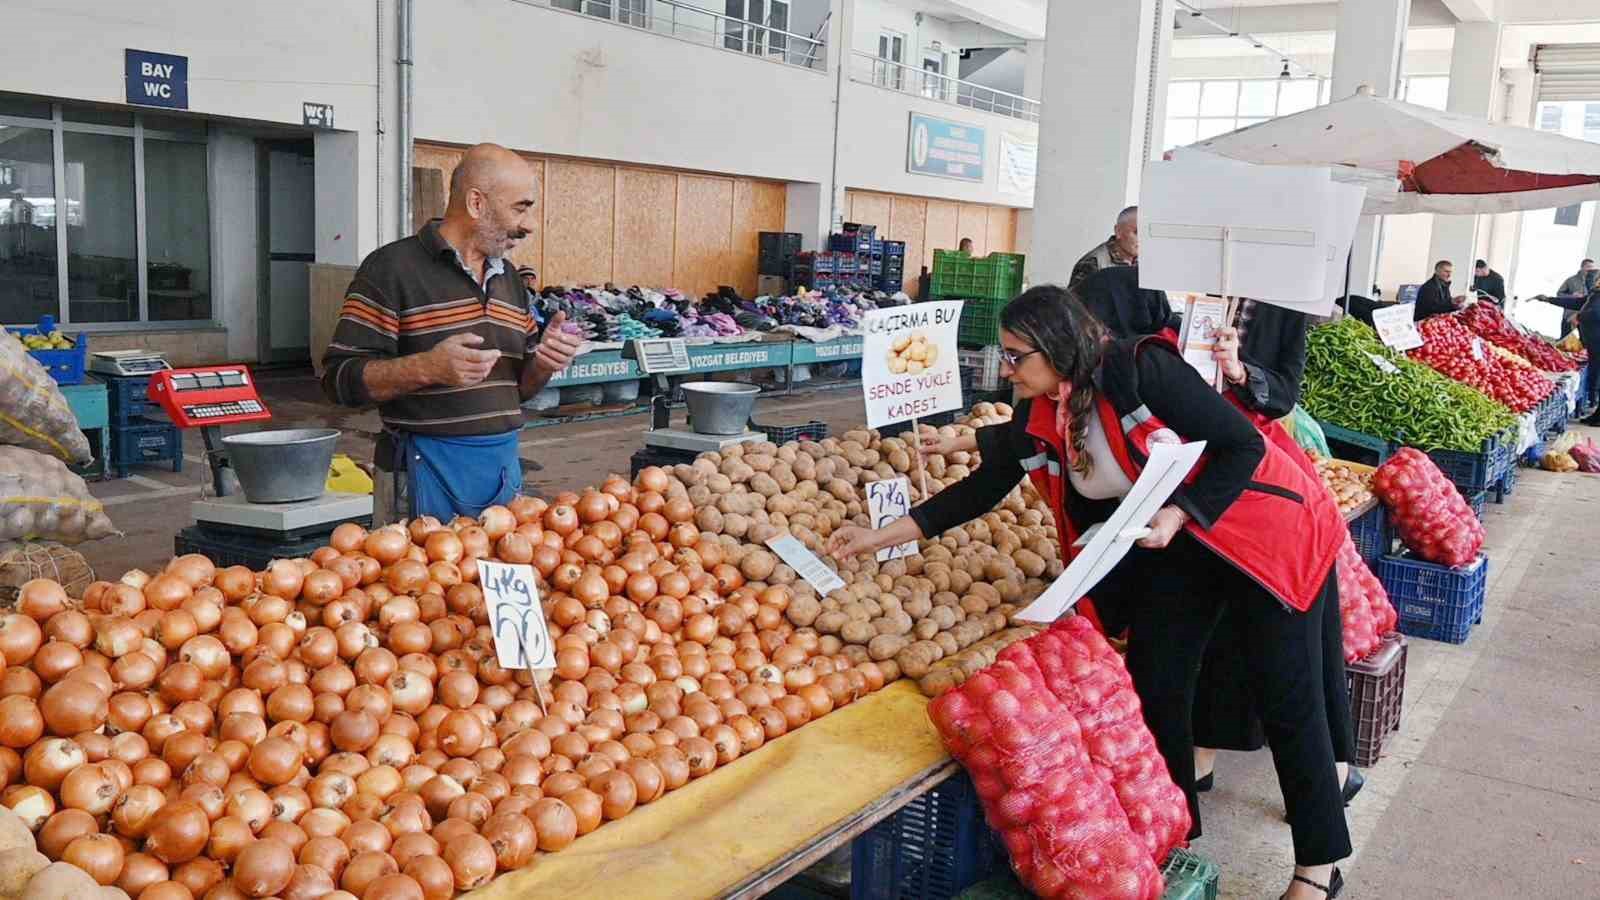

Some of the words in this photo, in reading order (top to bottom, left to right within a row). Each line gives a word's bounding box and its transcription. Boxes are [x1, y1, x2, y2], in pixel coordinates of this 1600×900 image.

[141, 62, 174, 79] BAY
[144, 82, 171, 98] WC
[304, 104, 324, 119] WC
[935, 308, 956, 325] BU
[690, 354, 724, 368] YOZGAT
[869, 378, 912, 401] SENDE
[496, 602, 547, 666] 50
